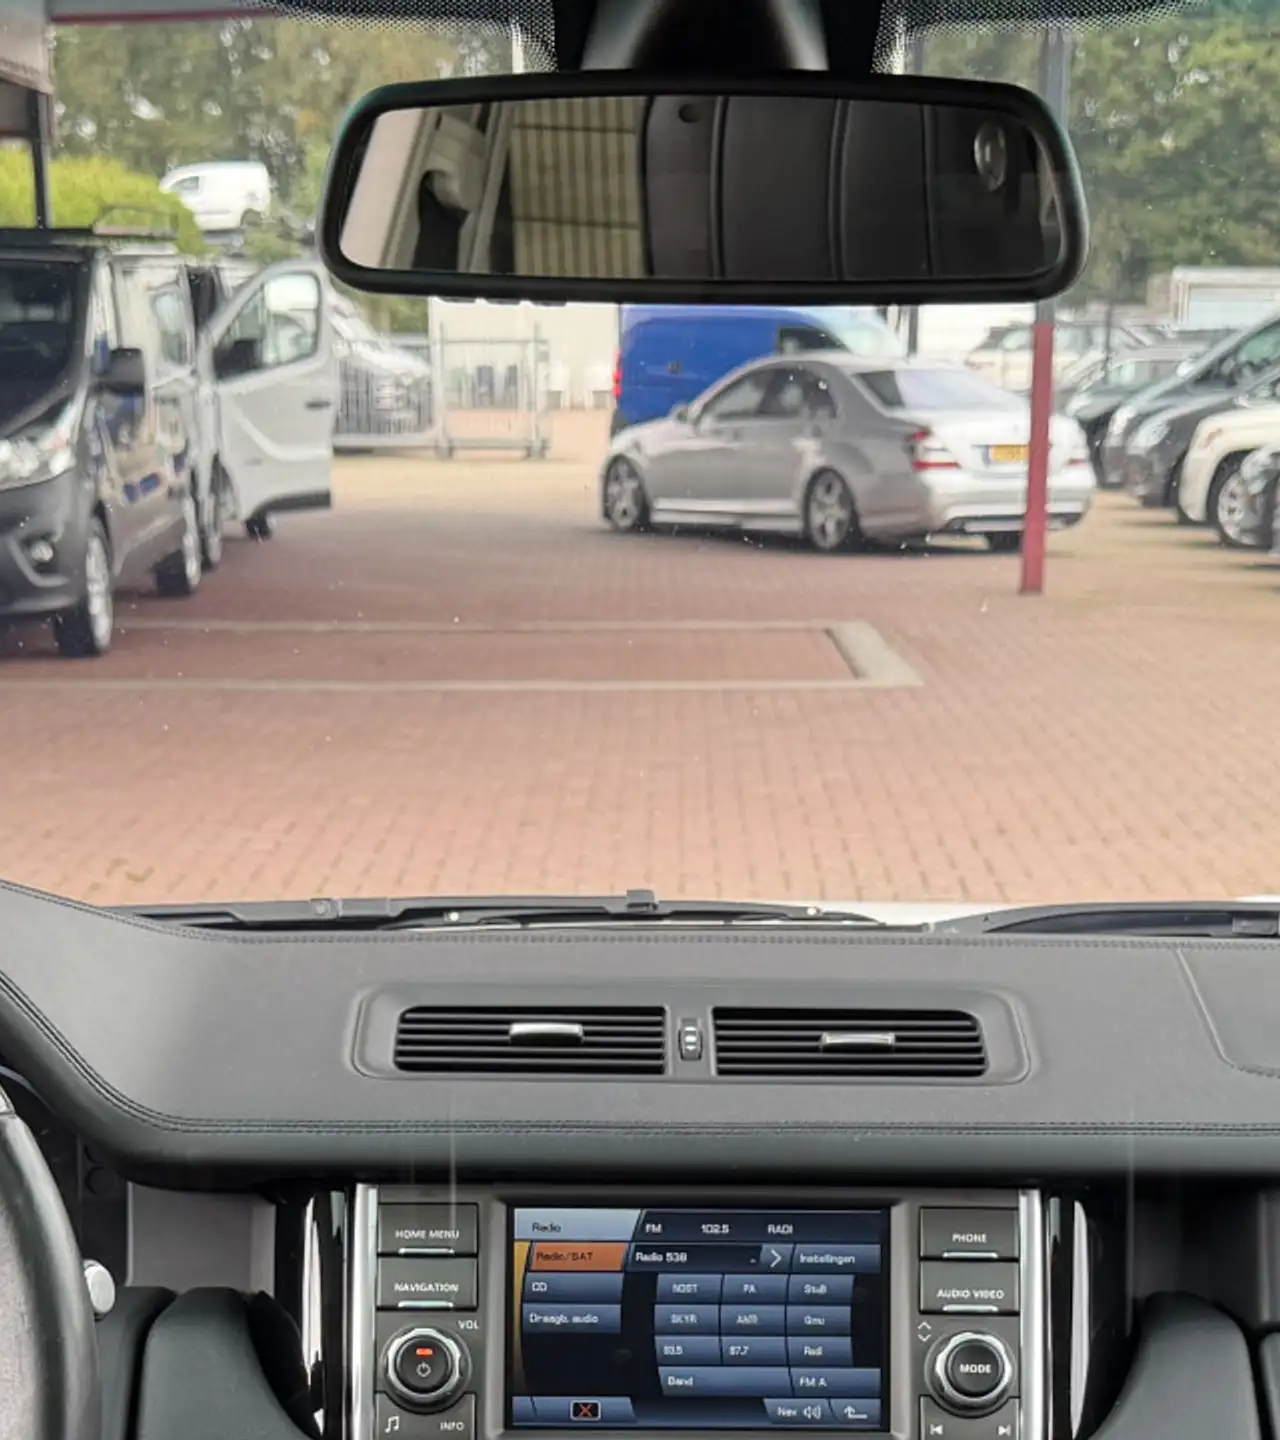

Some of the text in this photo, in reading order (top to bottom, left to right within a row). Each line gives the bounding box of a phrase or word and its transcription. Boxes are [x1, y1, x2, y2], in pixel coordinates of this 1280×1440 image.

[532, 1222, 561, 1233] Radio
[645, 1224, 662, 1233] FM
[701, 1224, 729, 1234] 102.5
[395, 1230, 460, 1239] HOME MENU
[952, 1234, 987, 1243] PHONE
[636, 1252, 663, 1261] Radio
[394, 1282, 459, 1292] NAVIGATION
[937, 1289, 1005, 1299] AUDIO VIDEO
[458, 1320, 479, 1329] VOL
[960, 1364, 991, 1373] MODE
[440, 1422, 464, 1431] INFO
